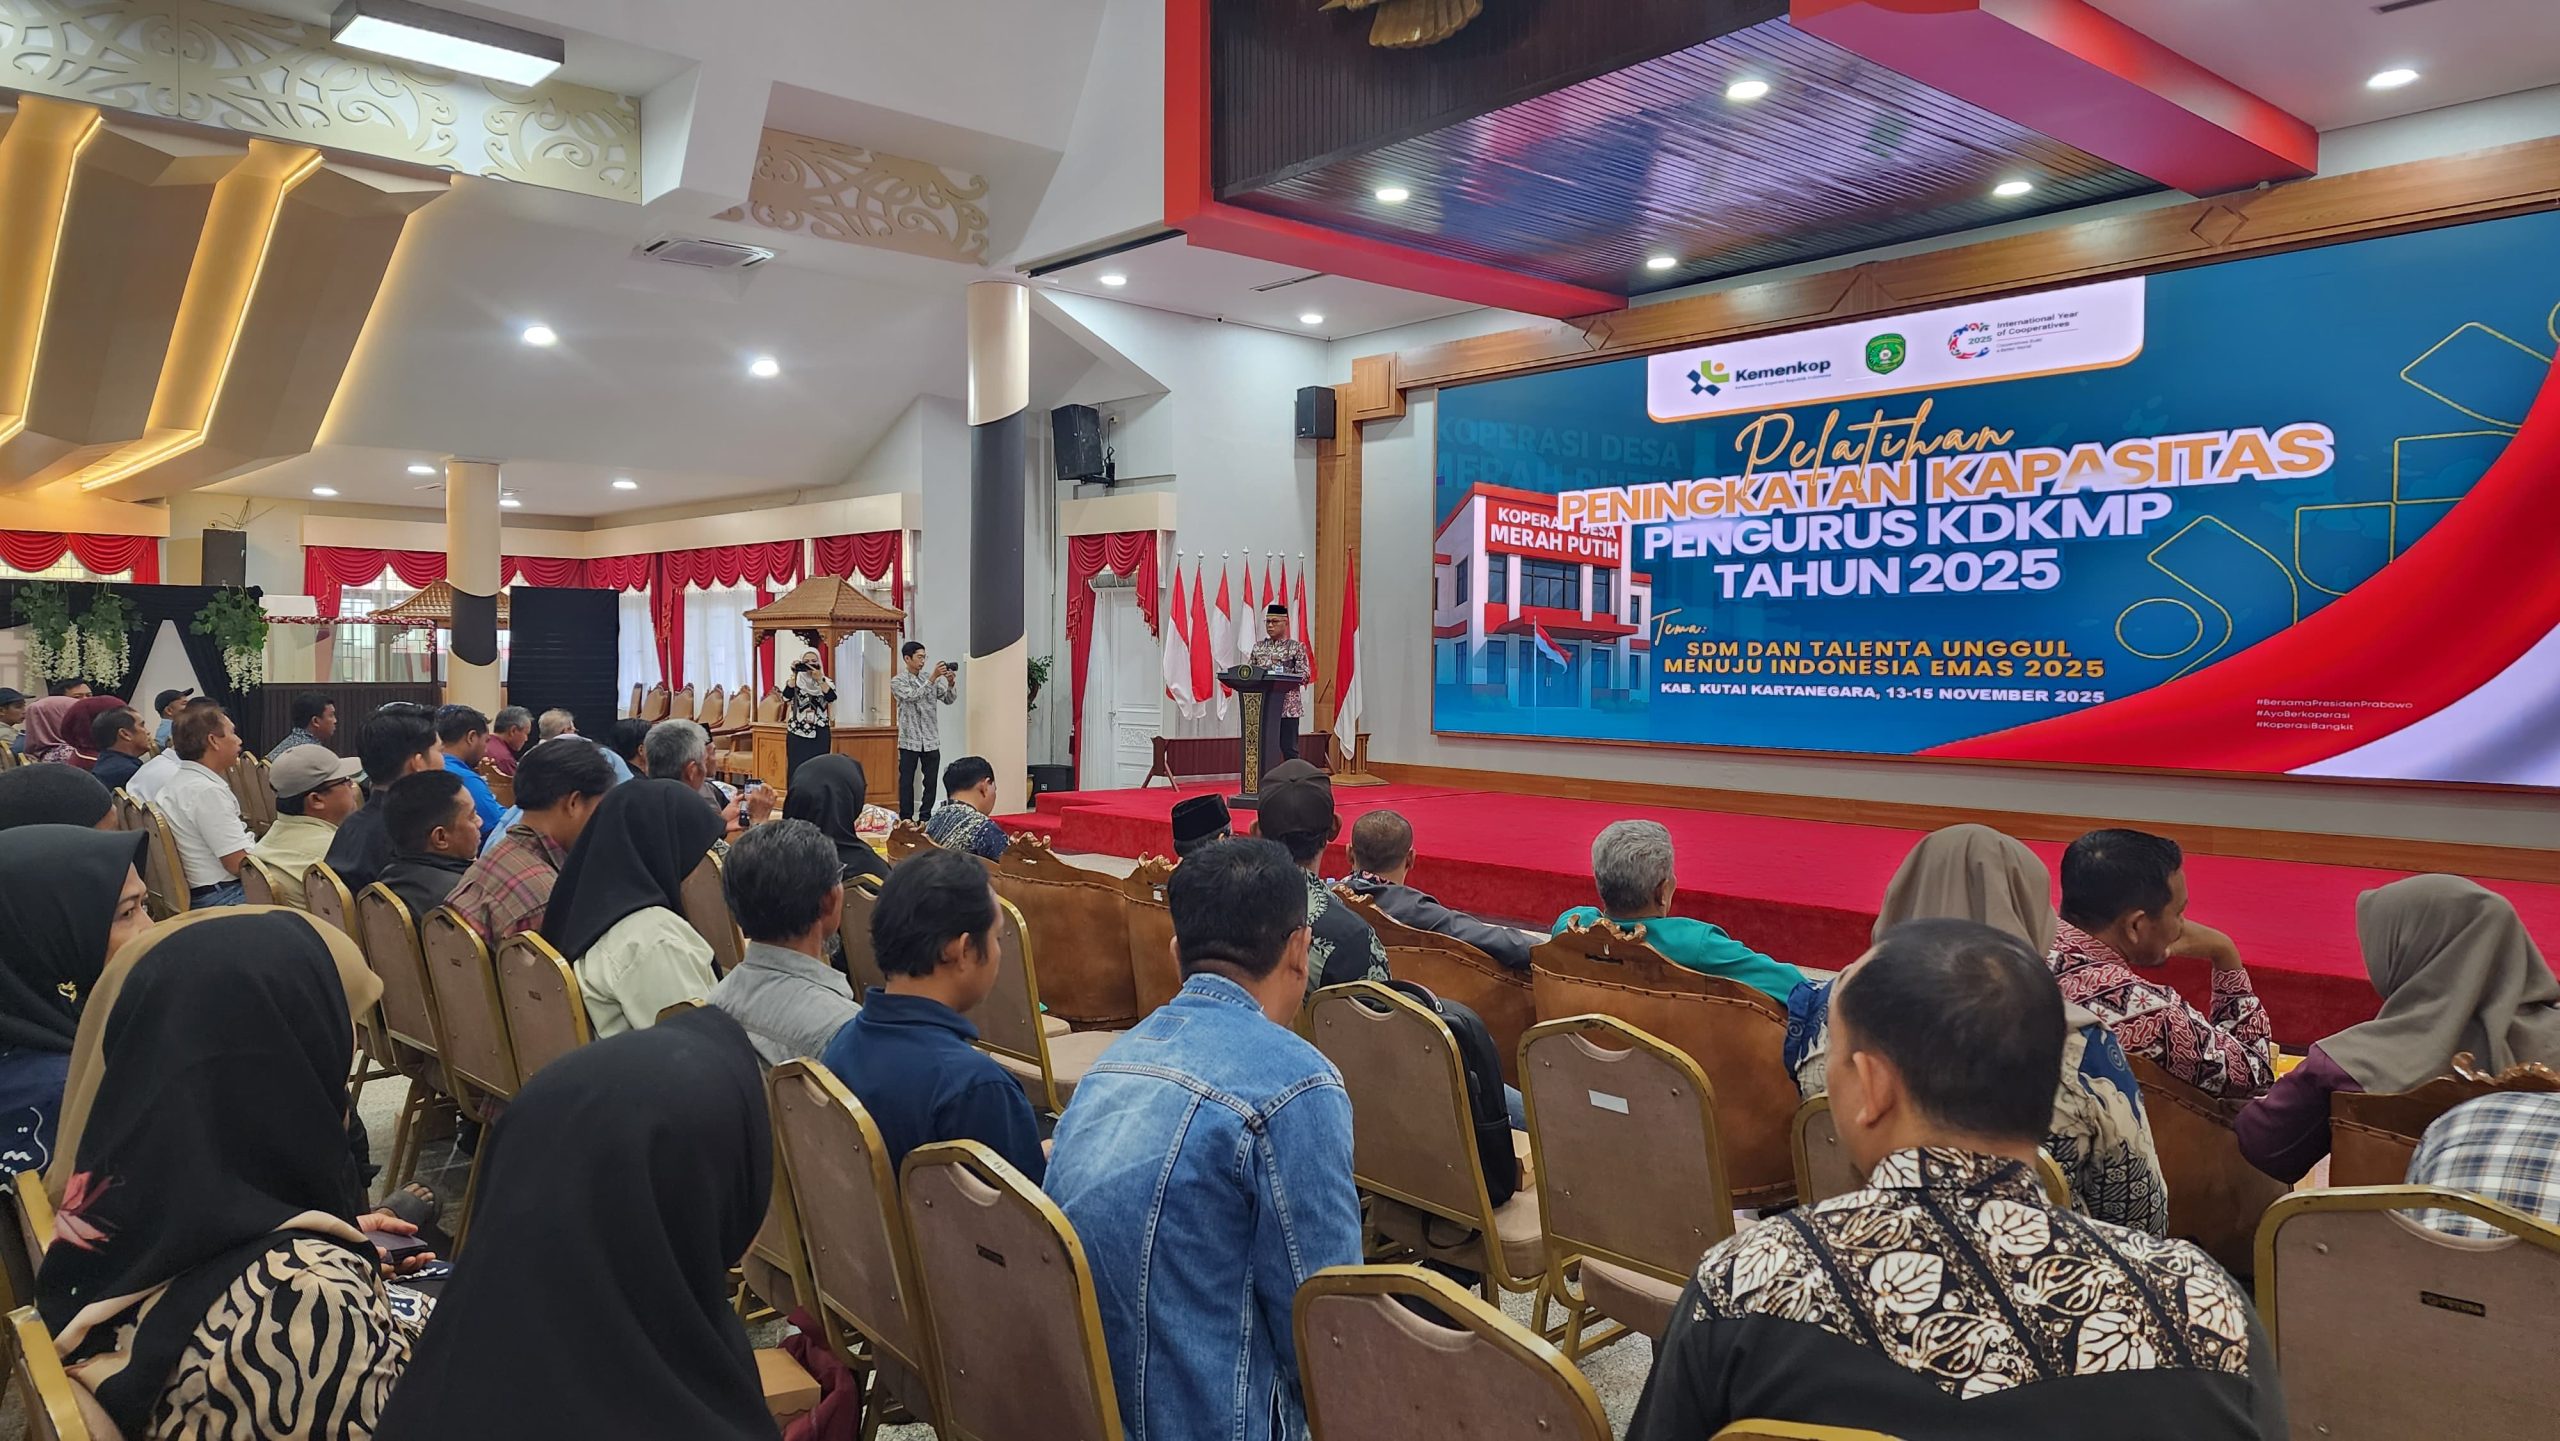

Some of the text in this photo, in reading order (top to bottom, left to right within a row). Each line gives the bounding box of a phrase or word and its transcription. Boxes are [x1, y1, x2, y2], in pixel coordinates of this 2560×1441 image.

[1996, 321, 2070, 337] of Cooperatives
[1997, 310, 2079, 329] International Year
[1967, 335, 1993, 345] 2025
[1735, 360, 1831, 382] Kemenkop
[1735, 399, 2014, 495] Pelatihan
[1558, 422, 2335, 528] PENINGKATAN KAPASITAS
[1644, 493, 2173, 559] PENGURUS KDKMP
[1490, 524, 1619, 559] MERAH PUTIH
[1714, 549, 2060, 598] TAHUN 2025
[1651, 608, 1708, 646] Tema:
[1687, 640, 2072, 657] SDM DAN TALENTA UNGGUL
[1664, 658, 2104, 678] MENUJU INDONESIA EMAS 2025
[1661, 683, 2105, 703] KAB. KUTAI KARTANEGARA, 13-15 NOVEMBER 2025
[2256, 698, 2413, 709] #BersamaPresidenPrabowo
[2256, 710, 2350, 719] #AyoBerkoperasi
[2256, 721, 2353, 731] #KoperasiBangkit
